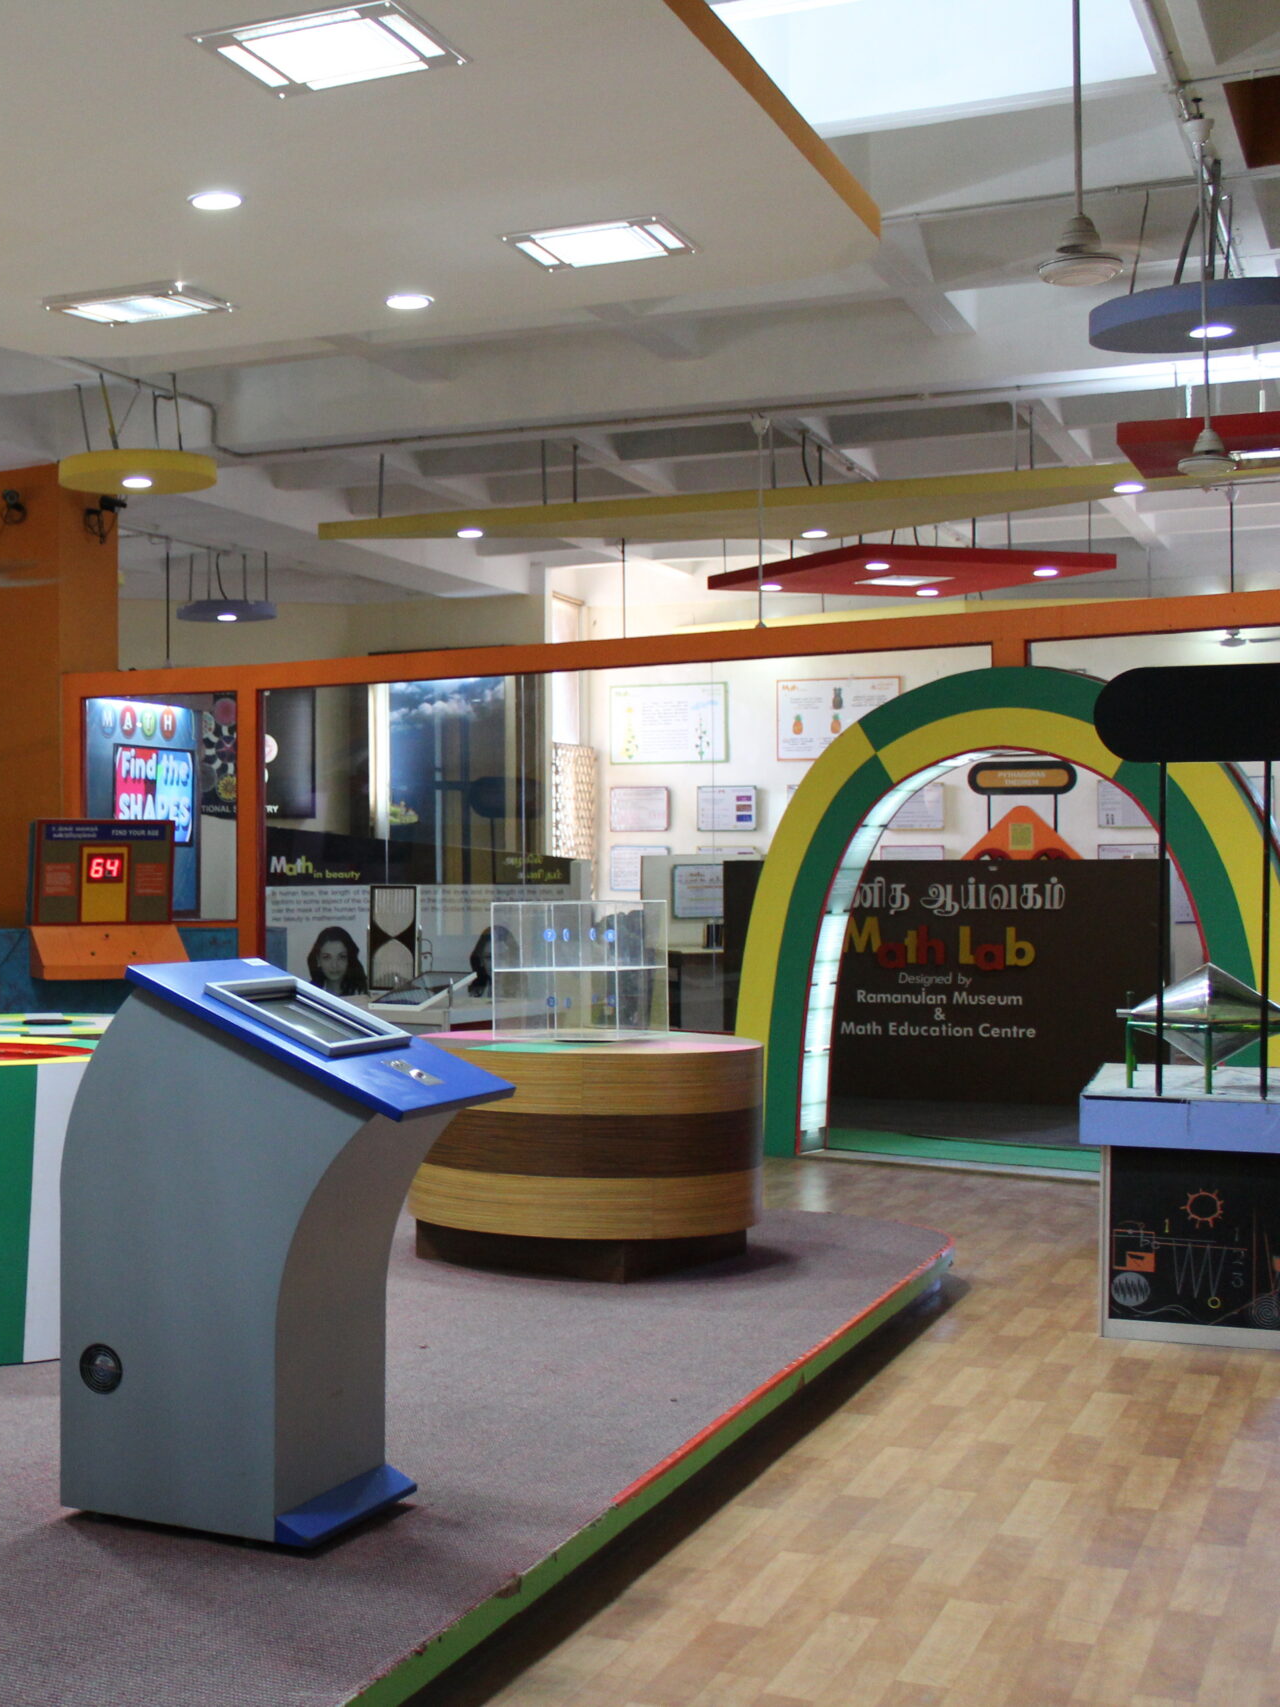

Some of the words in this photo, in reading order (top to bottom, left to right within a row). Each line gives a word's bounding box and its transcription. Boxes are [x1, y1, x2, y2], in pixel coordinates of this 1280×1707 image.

[121, 751, 157, 781] Find
[161, 754, 189, 784] the
[119, 793, 191, 828] SHAPES
[201, 805, 231, 813] TIONAL
[90, 858, 119, 878] 64
[270, 855, 313, 876] Math
[325, 869, 361, 880] beauty
[920, 877, 1066, 917] ஆய்வகம்
[843, 916, 945, 969] Math
[958, 925, 1036, 971] Lab
[898, 972, 953, 987] Designed
[957, 973, 972, 988] by
[952, 991, 1024, 1006] Museum
[933, 1007, 946, 1021] &
[840, 1022, 883, 1036] Math
[888, 1023, 973, 1038] Education
[978, 1024, 1037, 1038] Centre
